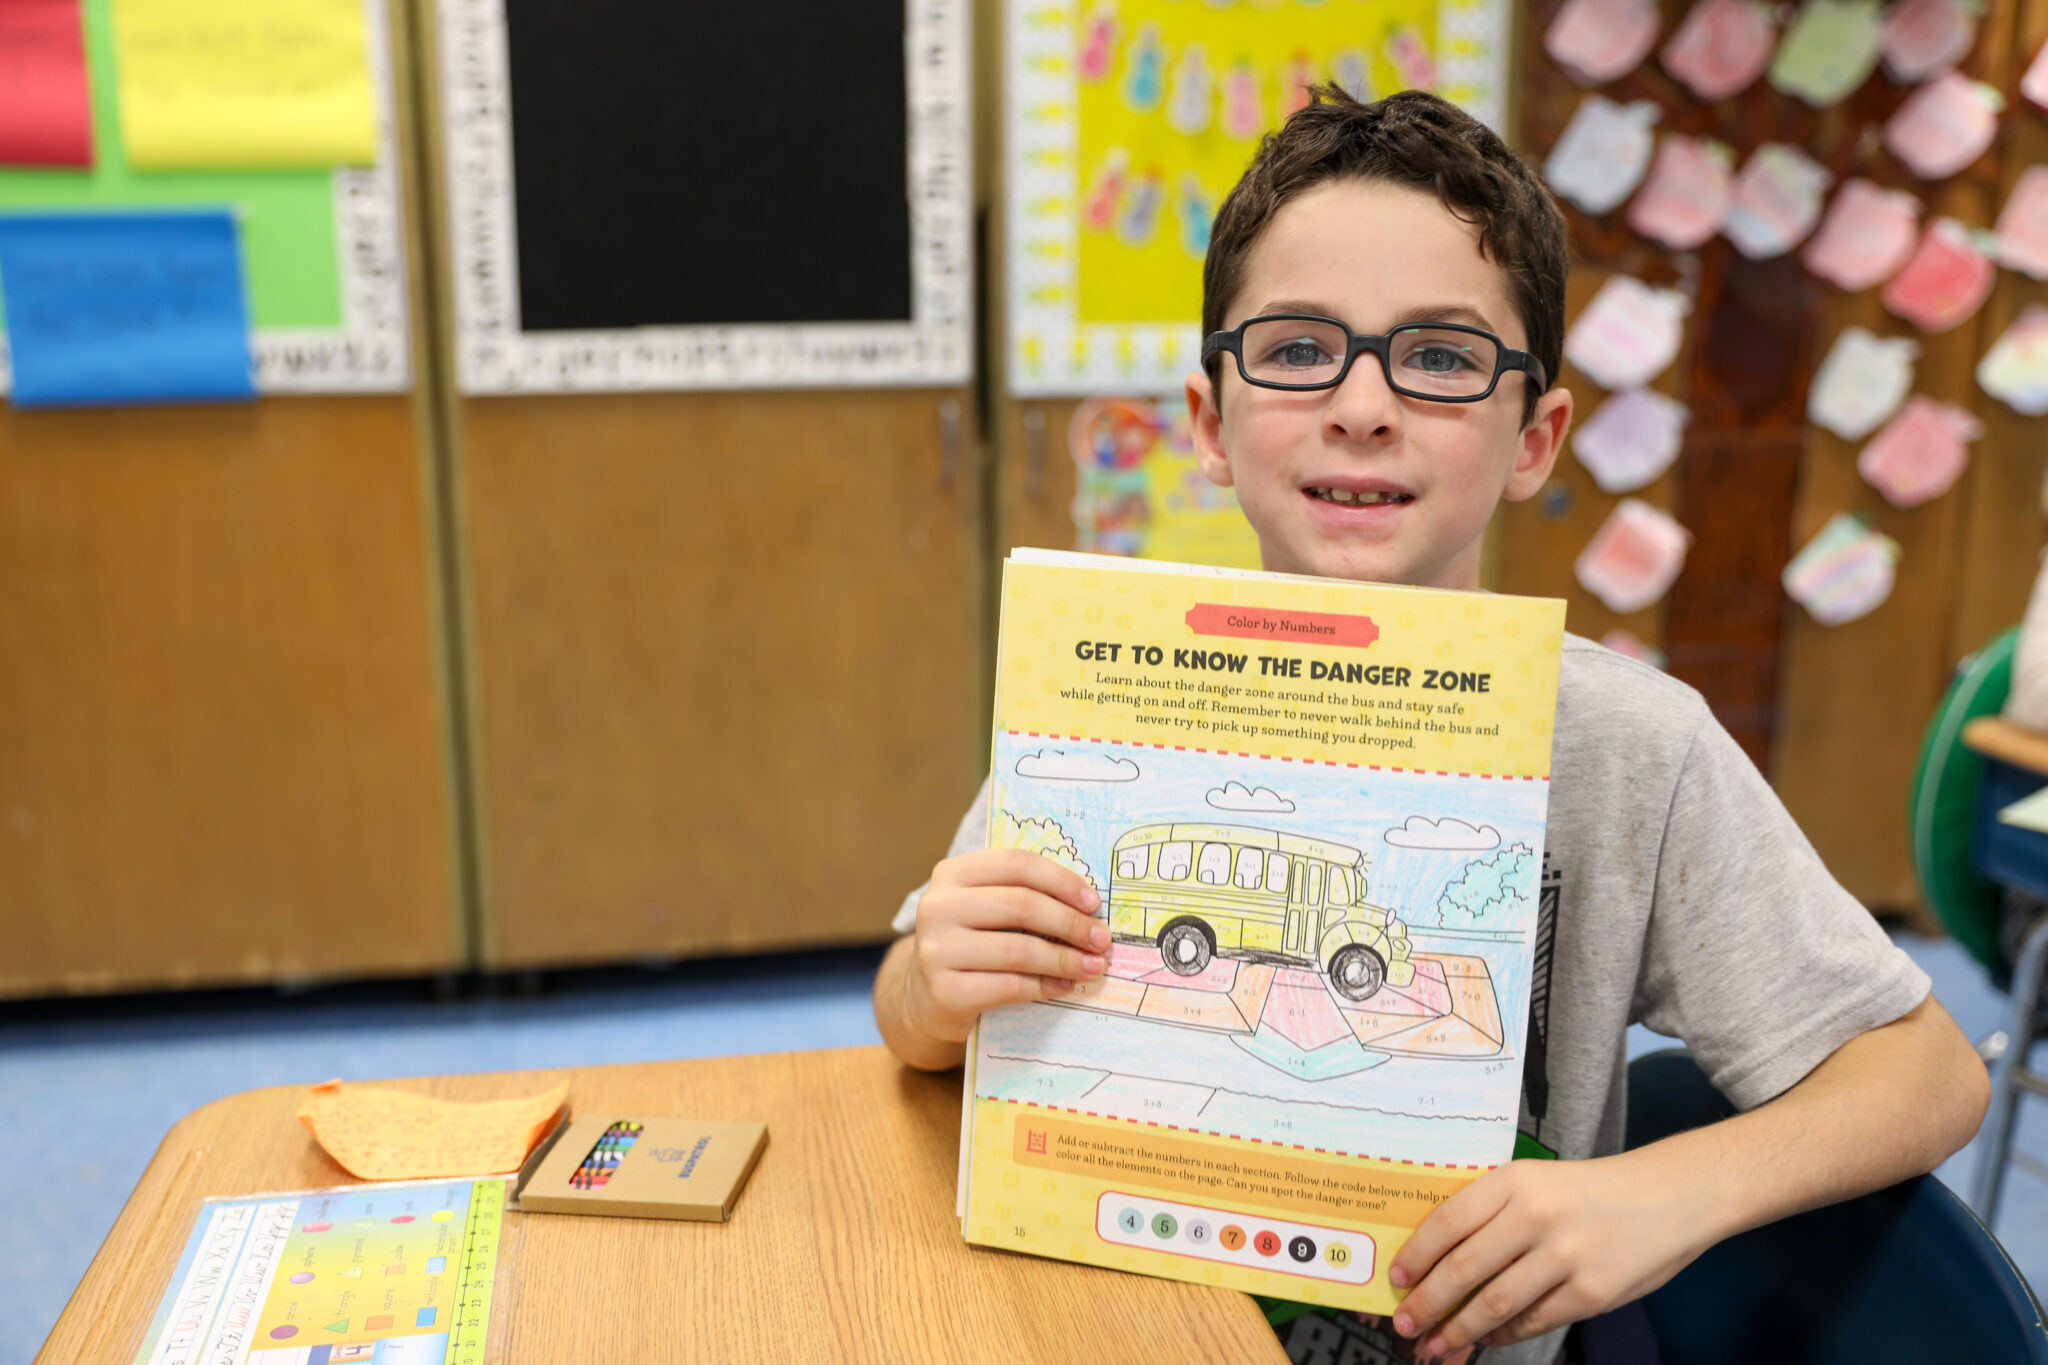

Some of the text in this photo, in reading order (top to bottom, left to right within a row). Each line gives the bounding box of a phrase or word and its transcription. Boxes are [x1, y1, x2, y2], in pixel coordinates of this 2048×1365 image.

[1227, 615, 1336, 635] Color by Numbers
[1075, 640, 1491, 693] GET TO KNOW THE DANGER ZONE
[1060, 687, 1499, 736] while getting on and off. Remember to never walk behind the bus and
[1095, 672, 1465, 715] Learn about the danger zone around the bus and stay safe
[1135, 714, 1416, 750] never try to pick up something you dropped.
[678, 1136, 711, 1178] BUSPATROL
[1057, 1133, 1077, 1147] Add
[1078, 1139, 1090, 1148] or
[1091, 1140, 1135, 1157] subtract
[1136, 1147, 1153, 1160] the
[1155, 1151, 1201, 1168] numbers
[1203, 1158, 1214, 1169] in
[1215, 1162, 1240, 1174] each
[1242, 1166, 1281, 1181] section.
[1285, 1170, 1320, 1186] Follow
[1322, 1176, 1340, 1189] the
[1341, 1180, 1366, 1193] code
[1368, 1183, 1401, 1198] below
[1403, 1188, 1414, 1199] to
[1416, 1189, 1440, 1204] help
[1056, 1151, 1387, 1211] color all the elements on the page. Can you spot the danger zone?
[1014, 1226, 1026, 1237] 15
[1126, 1215, 1346, 1263] 4 5 6 7 8 9 10
